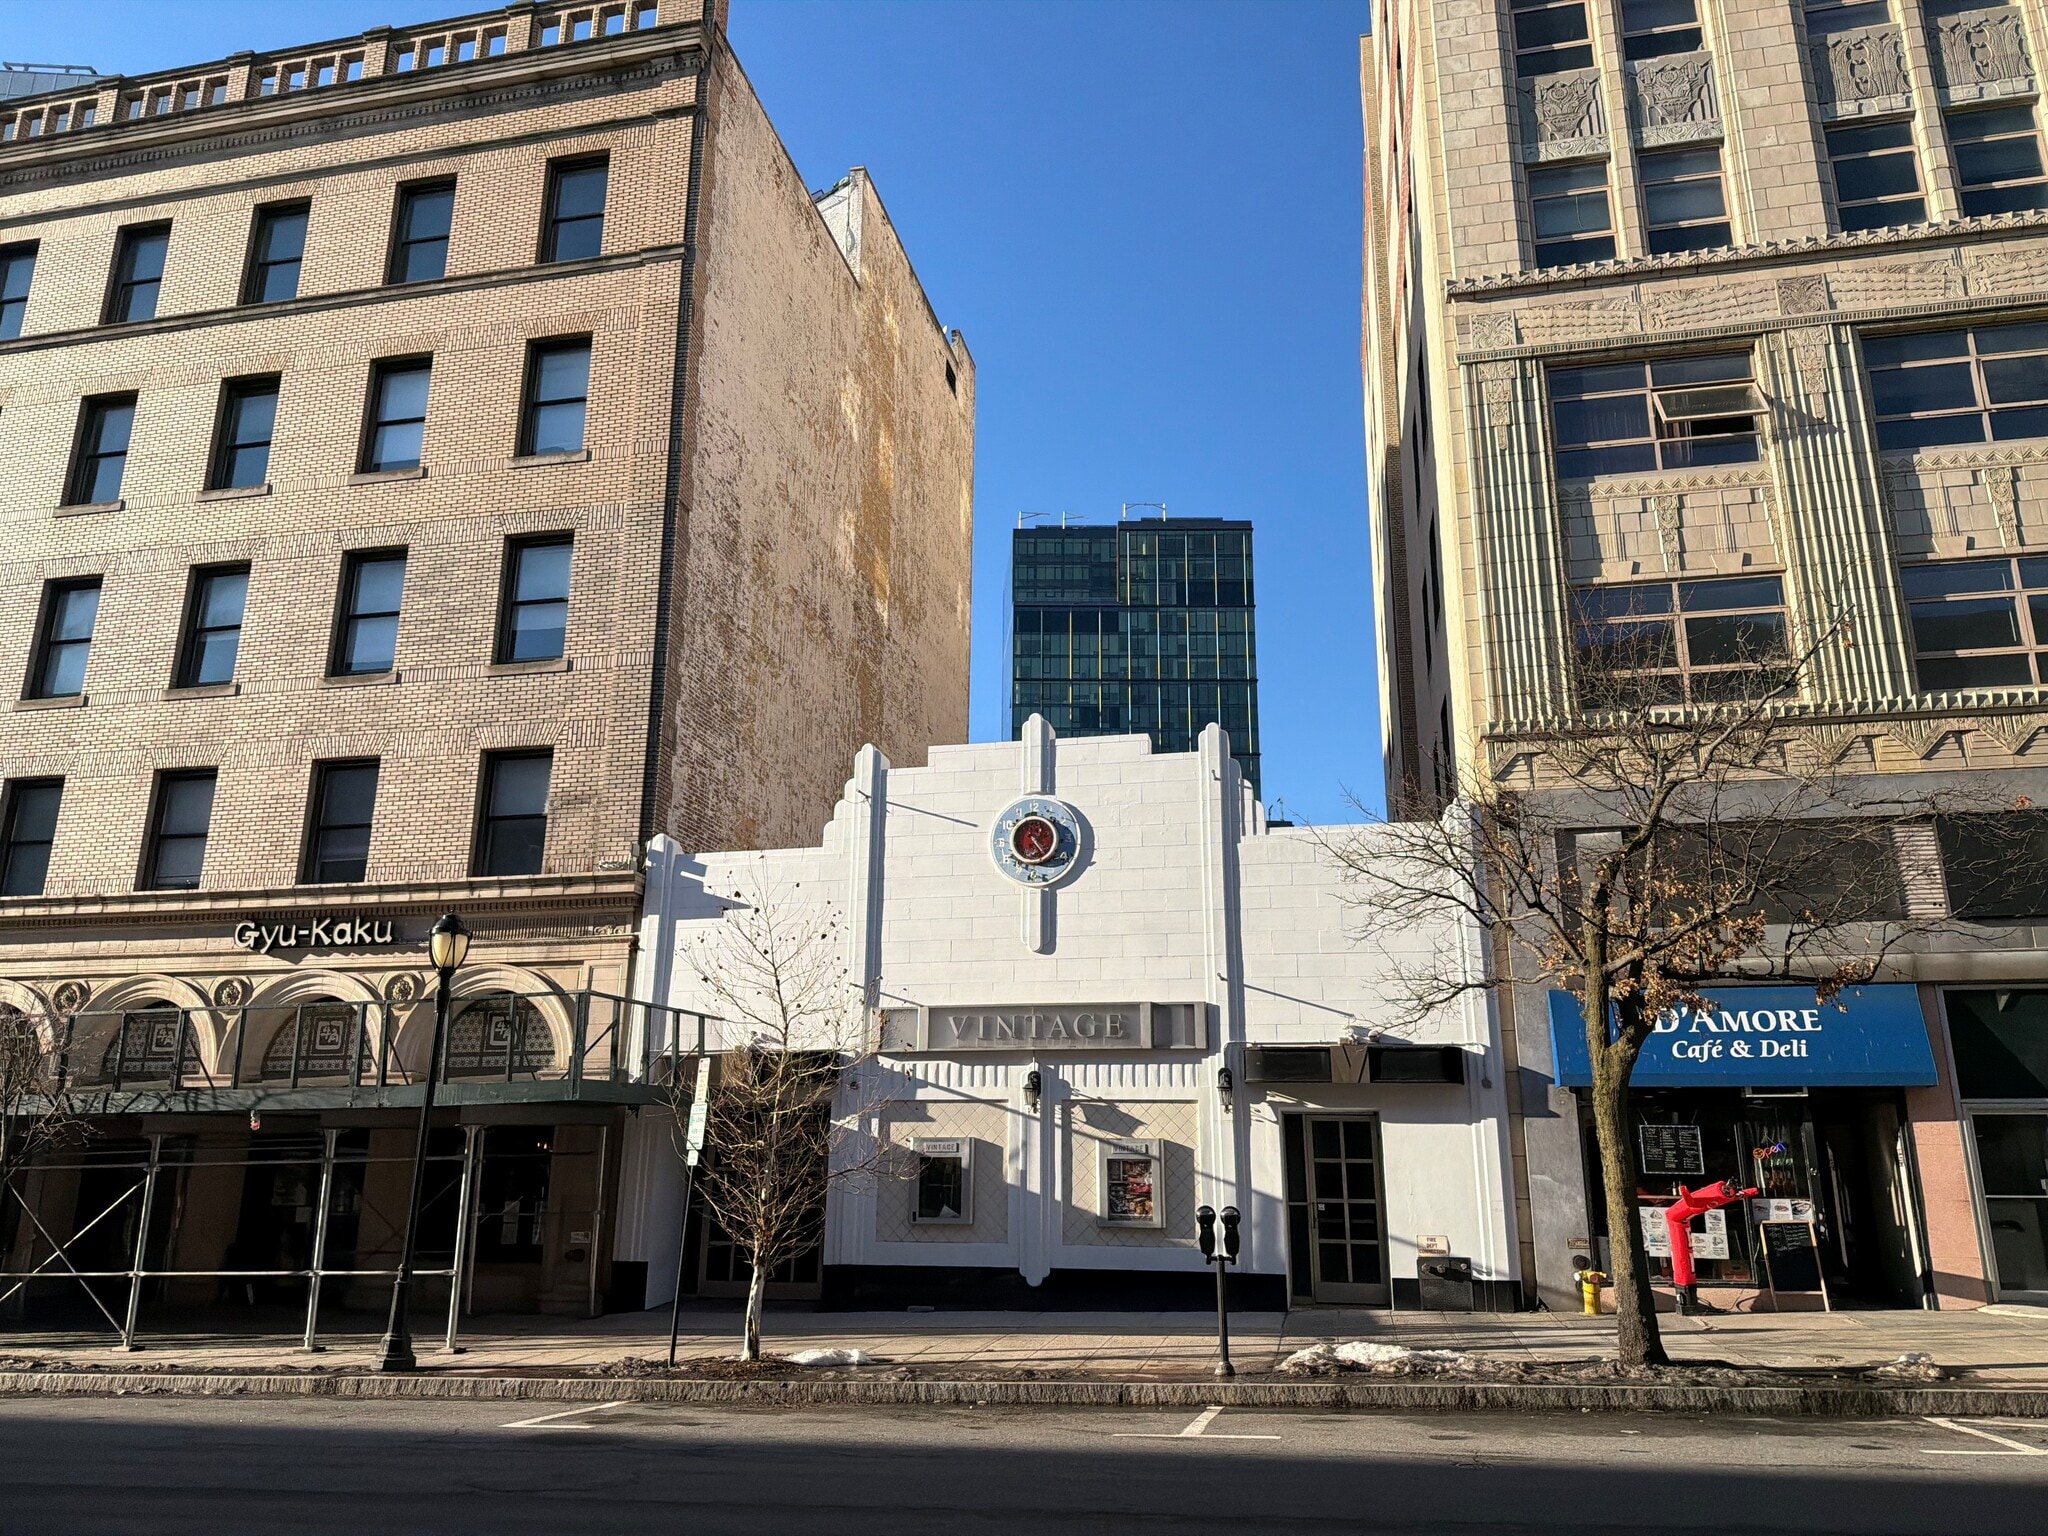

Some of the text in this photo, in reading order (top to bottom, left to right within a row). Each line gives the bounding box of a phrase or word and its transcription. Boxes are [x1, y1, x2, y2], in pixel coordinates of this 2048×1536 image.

[1029, 803, 1040, 811] 12
[234, 915, 393, 954] Gyu-Kaku
[947, 1013, 1124, 1039] VINTAGE
[1652, 1007, 1822, 1033] D'AMORE
[1672, 1039, 1809, 1062] Café & Deli
[1113, 1144, 1144, 1153] VINTAGE
